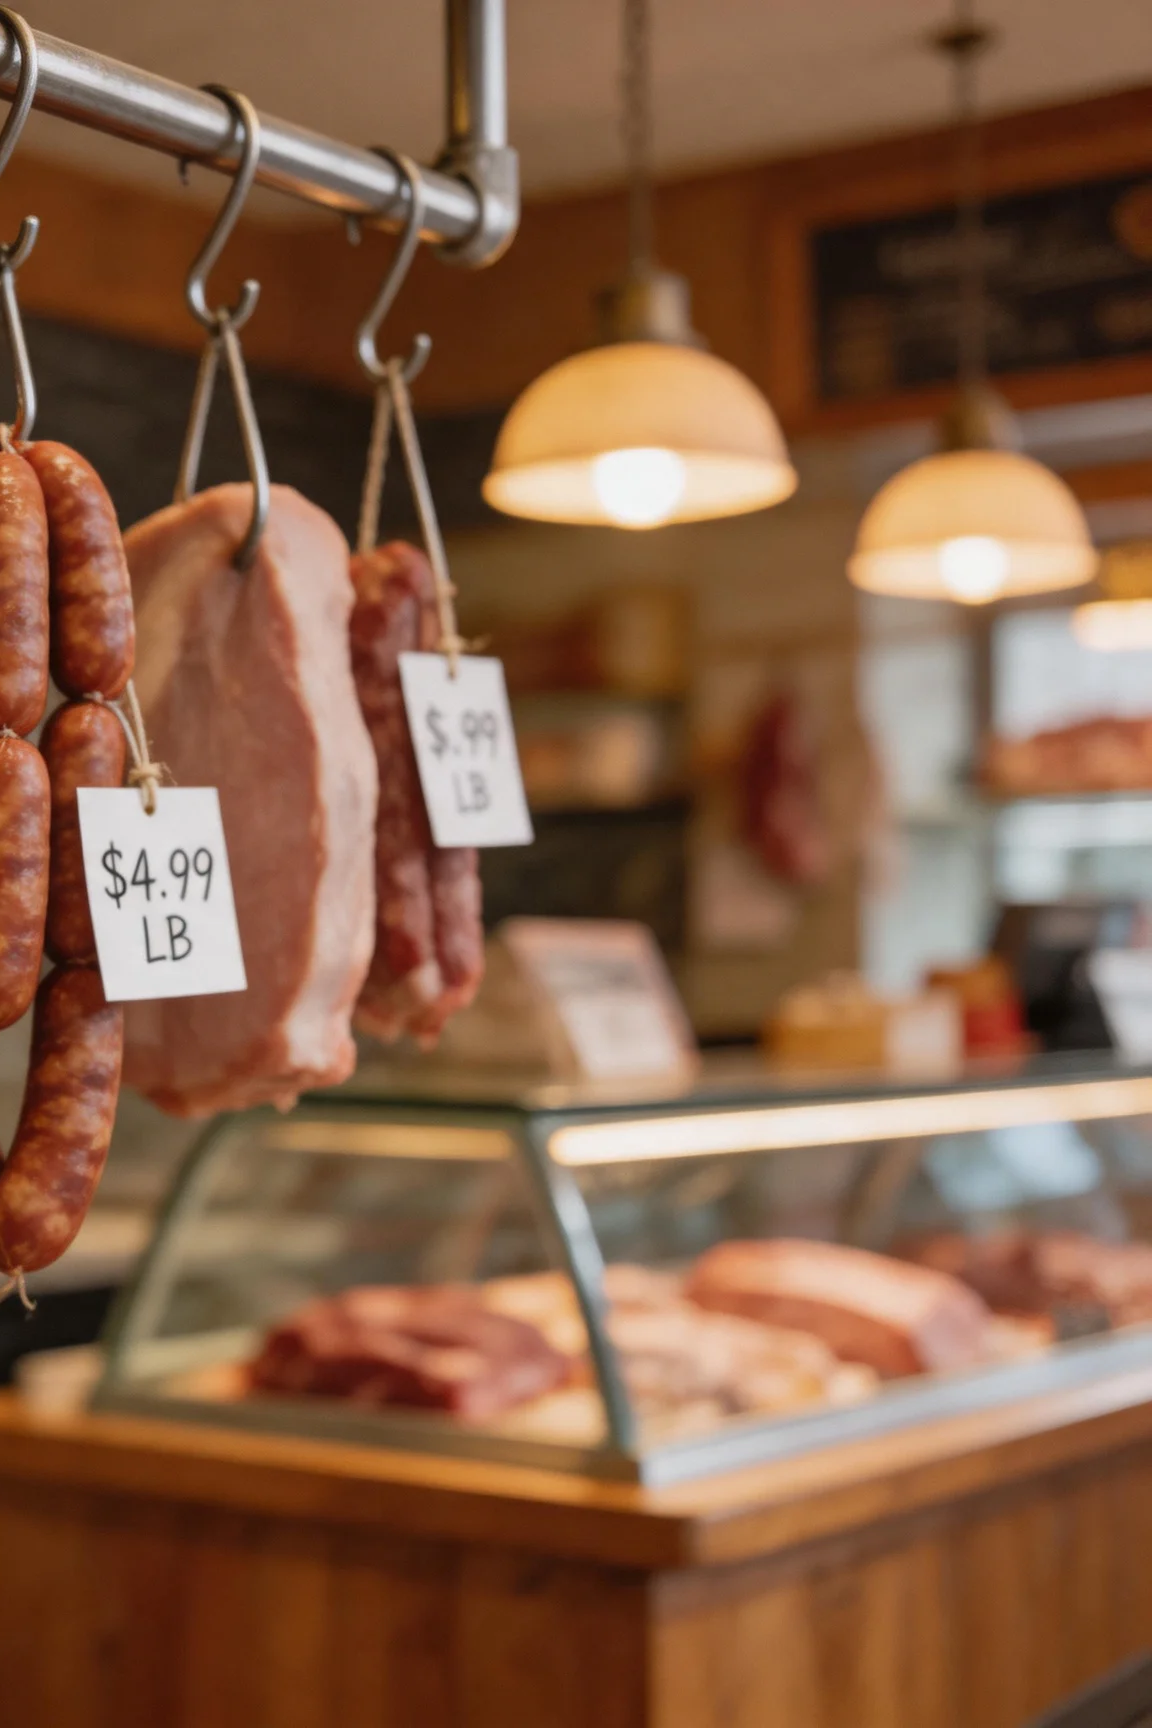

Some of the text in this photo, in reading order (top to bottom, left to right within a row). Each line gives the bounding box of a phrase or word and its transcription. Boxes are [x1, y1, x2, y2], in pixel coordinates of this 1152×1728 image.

[452, 770, 491, 814] LB
[101, 841, 213, 909] $4.99
[143, 915, 192, 964] LB
